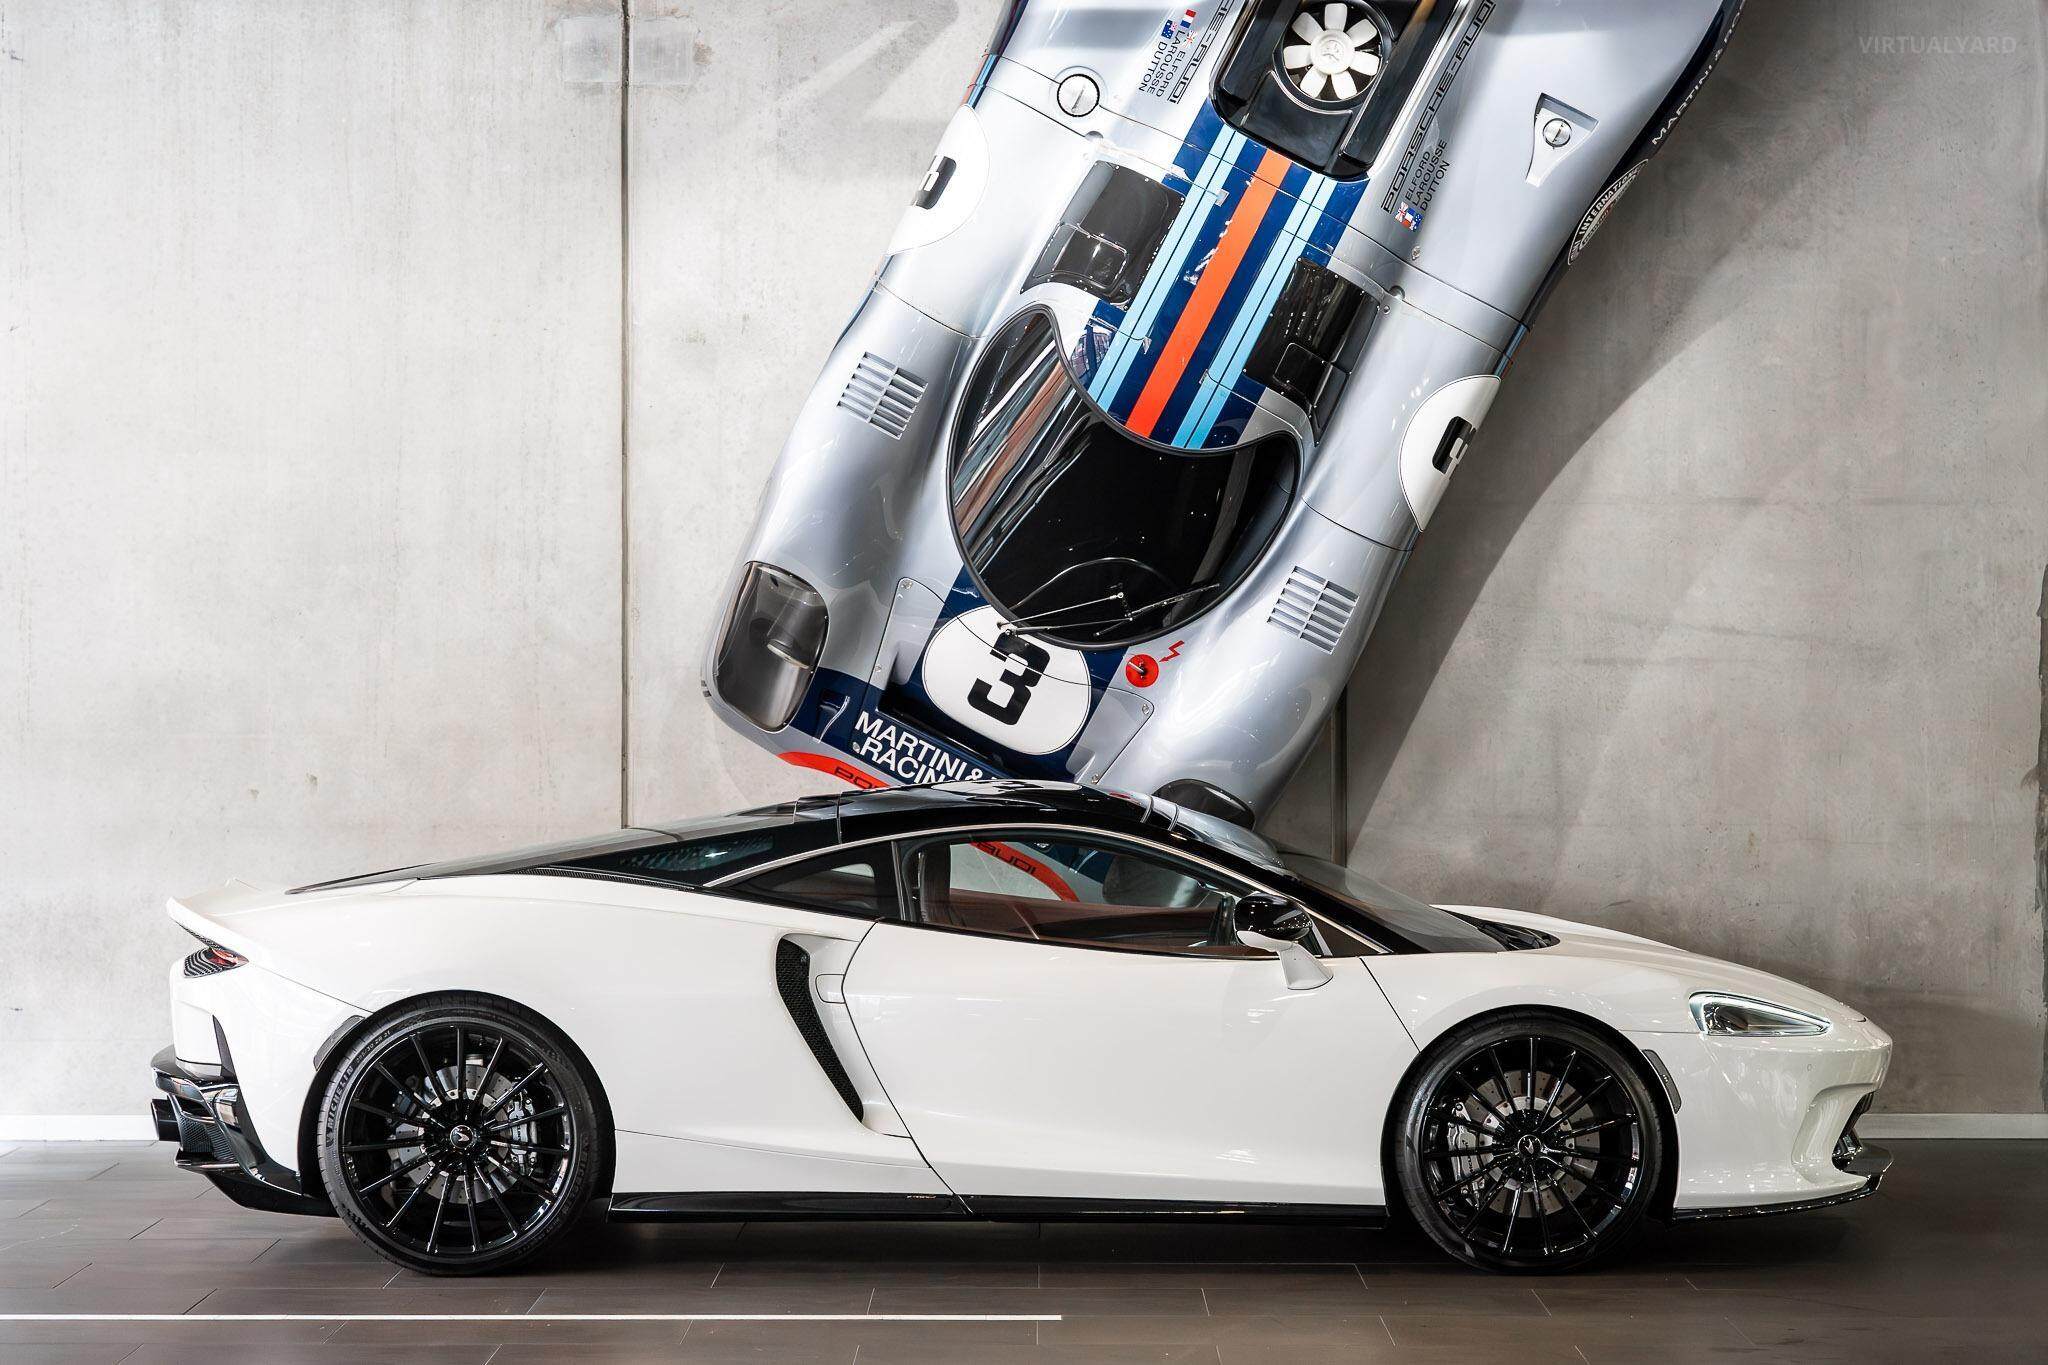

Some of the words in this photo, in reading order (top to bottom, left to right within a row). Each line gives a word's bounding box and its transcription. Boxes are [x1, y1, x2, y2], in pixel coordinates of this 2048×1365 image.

[1138, 41, 1168, 92] DUTTON
[1147, 30, 1186, 94] LAROUSSE
[1155, 50, 1186, 97] ELFORD
[1382, 0, 1494, 213] PORSCHE-AUDI
[1405, 151, 1431, 201] ELFORD
[1412, 139, 1448, 207] LAROUSSE
[1420, 160, 1451, 211] DUTTON
[967, 632, 1050, 726] 3
[834, 766, 879, 789] PO
[855, 711, 968, 780] MARTINI
[326, 1064, 355, 1129] MICHELIN
